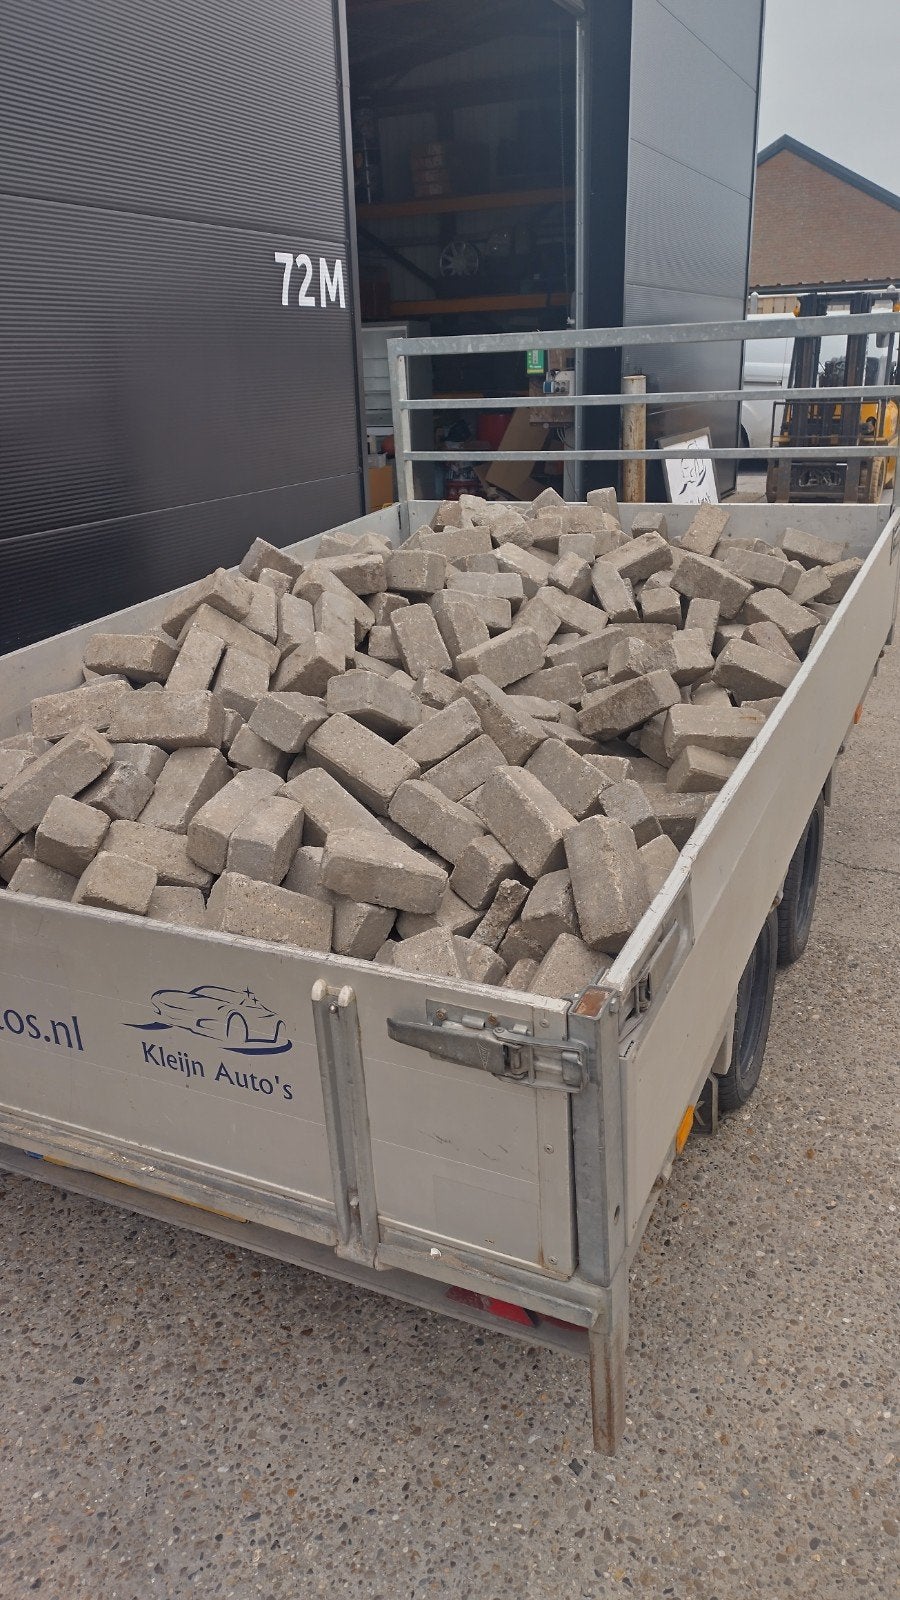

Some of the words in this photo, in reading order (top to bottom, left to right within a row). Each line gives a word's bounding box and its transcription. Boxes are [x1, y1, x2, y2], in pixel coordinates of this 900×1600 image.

[0, 1009, 84, 1051] os.nl
[141, 1041, 205, 1078] Kleijn
[214, 1061, 293, 1100] Auto's
